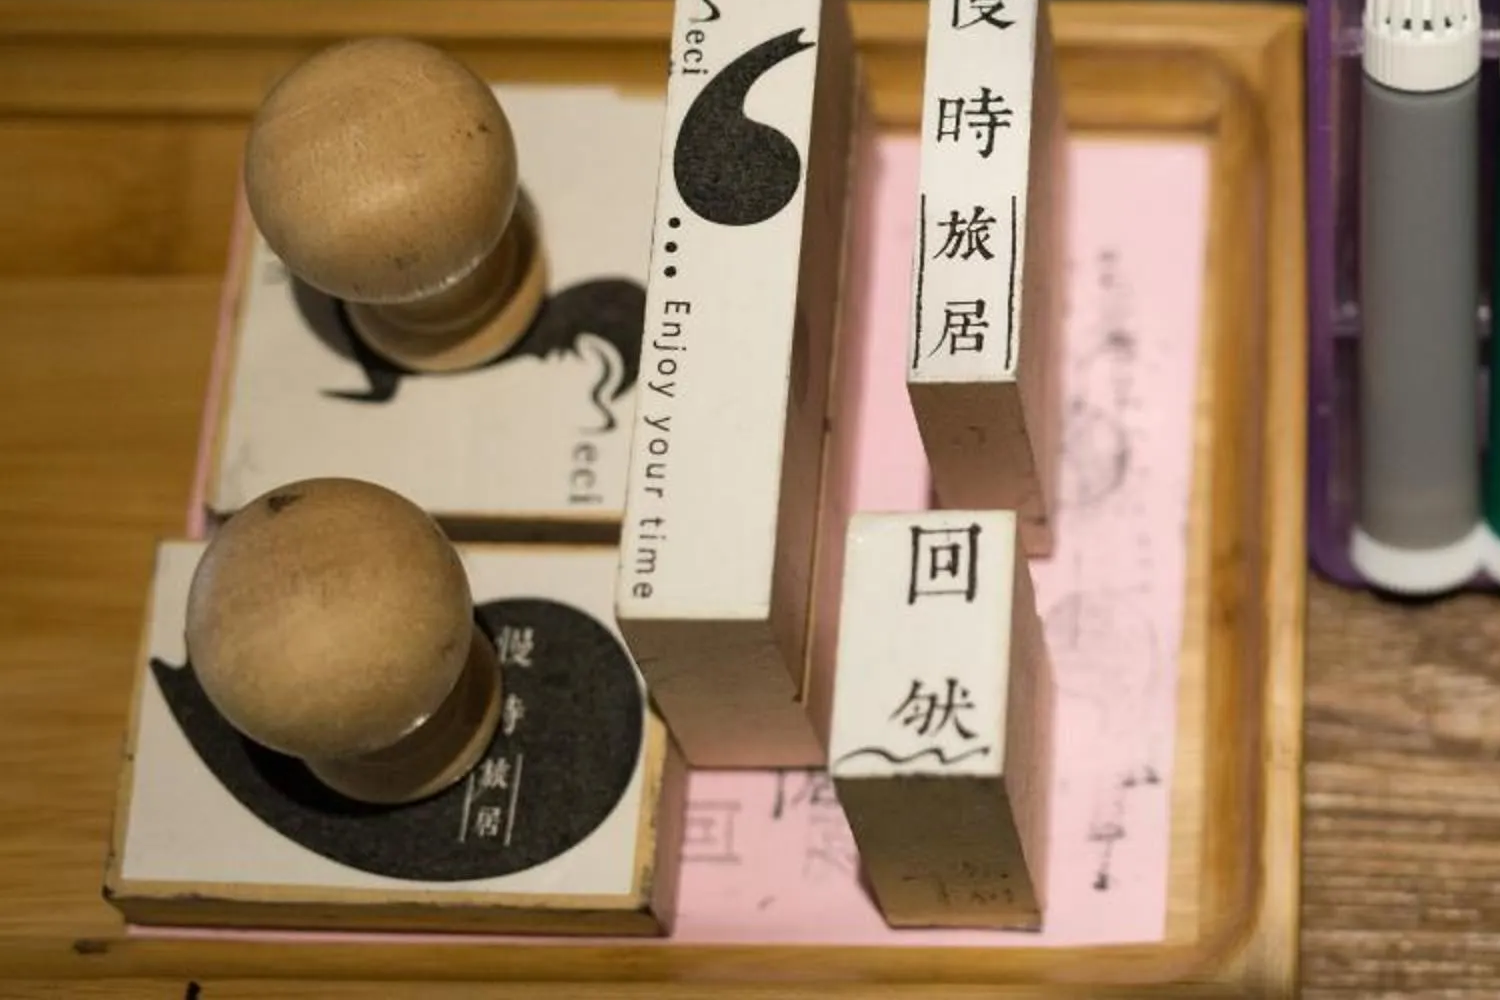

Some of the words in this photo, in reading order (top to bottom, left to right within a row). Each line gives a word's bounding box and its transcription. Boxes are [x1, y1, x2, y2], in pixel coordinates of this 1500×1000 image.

[648, 300, 691, 399] Enjoy
[644, 415, 673, 499] your
[632, 517, 667, 600] time
